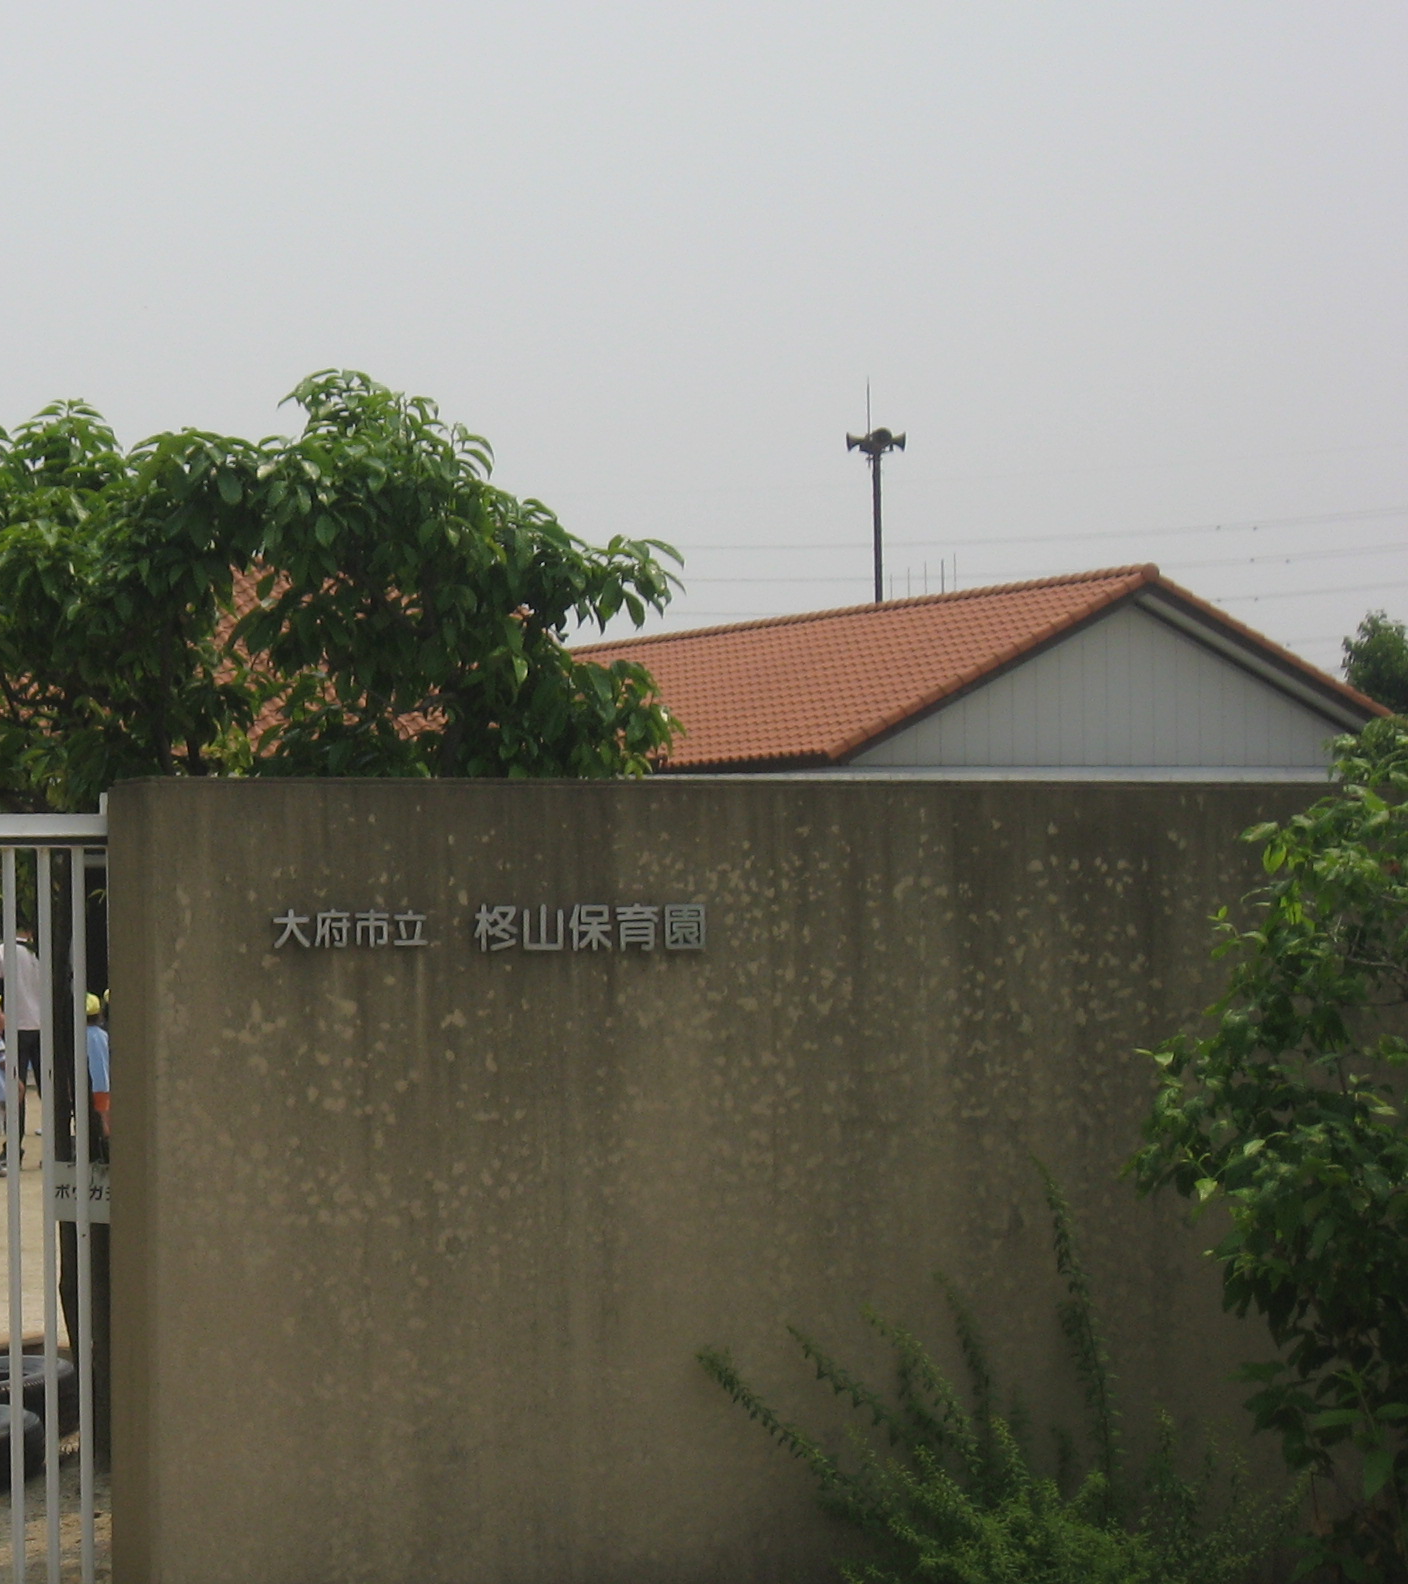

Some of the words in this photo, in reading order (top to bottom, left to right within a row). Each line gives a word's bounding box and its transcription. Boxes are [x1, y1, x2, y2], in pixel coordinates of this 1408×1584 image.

[273, 908, 428, 949] 大府市立
[474, 903, 706, 952] 柊山保育園
